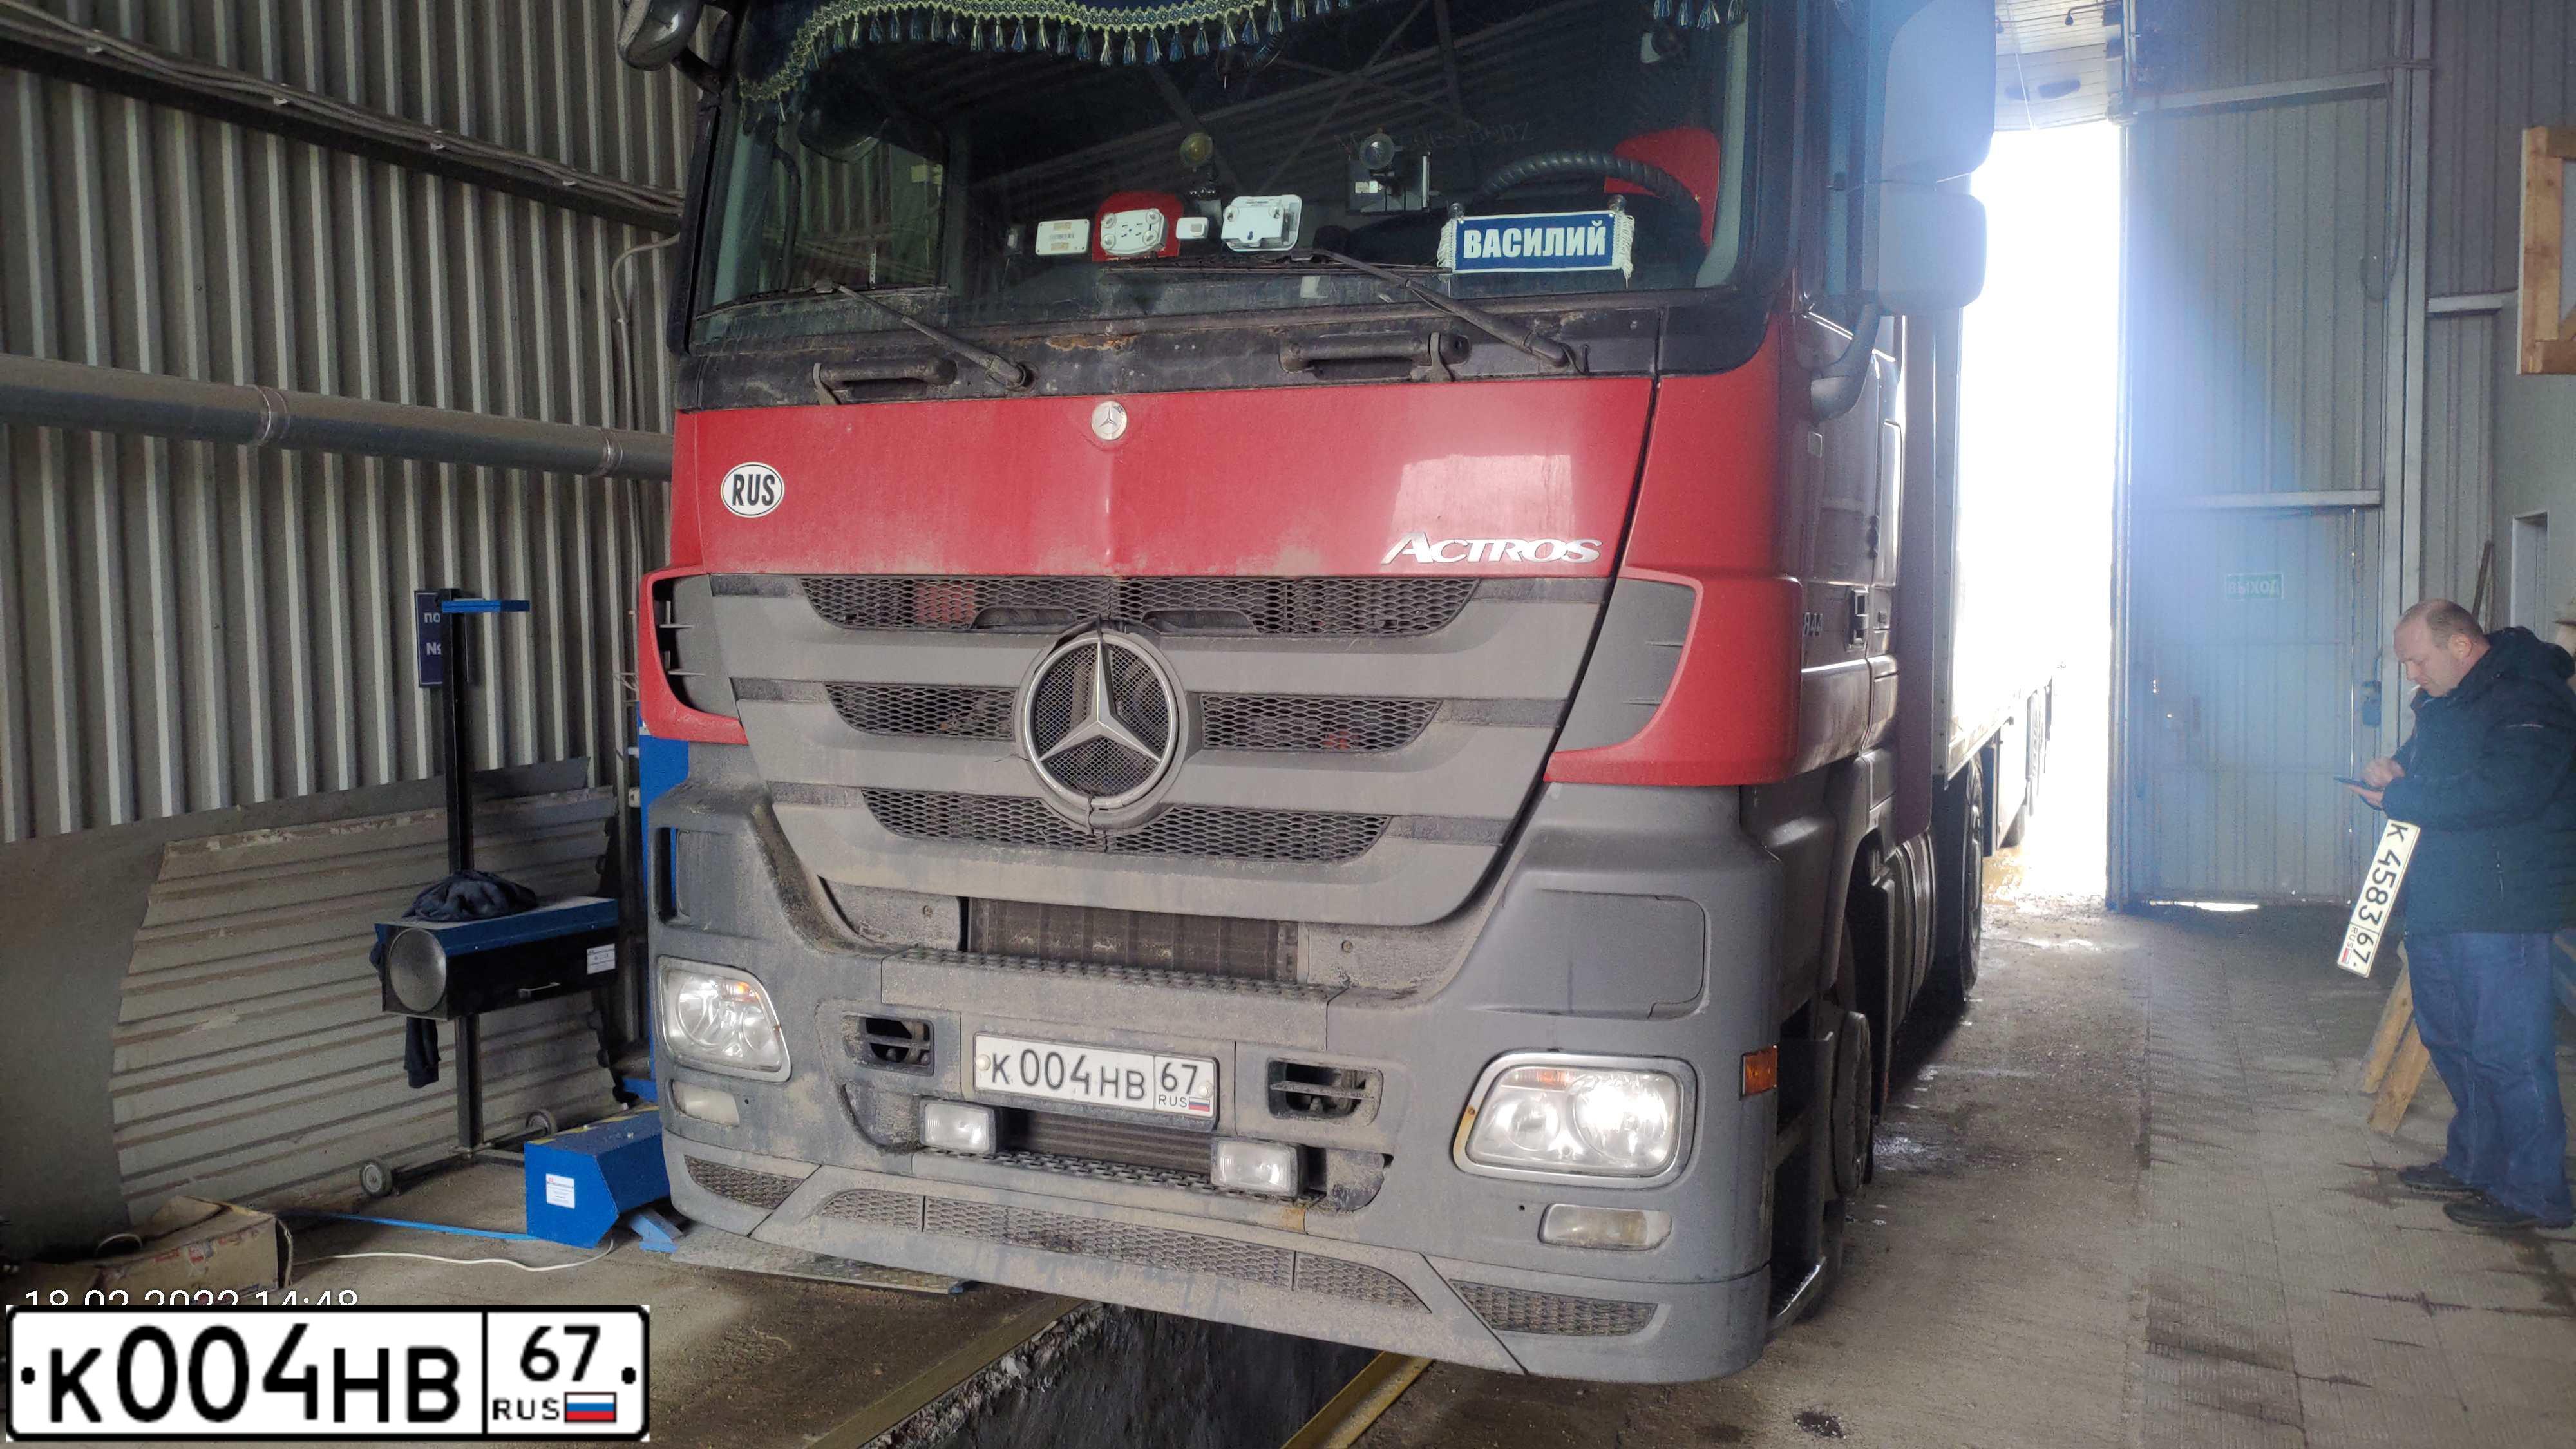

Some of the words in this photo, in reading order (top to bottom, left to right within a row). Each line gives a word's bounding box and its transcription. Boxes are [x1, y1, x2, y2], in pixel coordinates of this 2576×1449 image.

[1463, 220, 1606, 258] ВАСИЛИЙ
[732, 474, 775, 506] RUS
[2228, 580, 2280, 596] ВЫХОД
[2353, 933, 2374, 963] 67
[1161, 1062, 1198, 1094] 67
[1159, 1095, 1188, 1108] RUS
